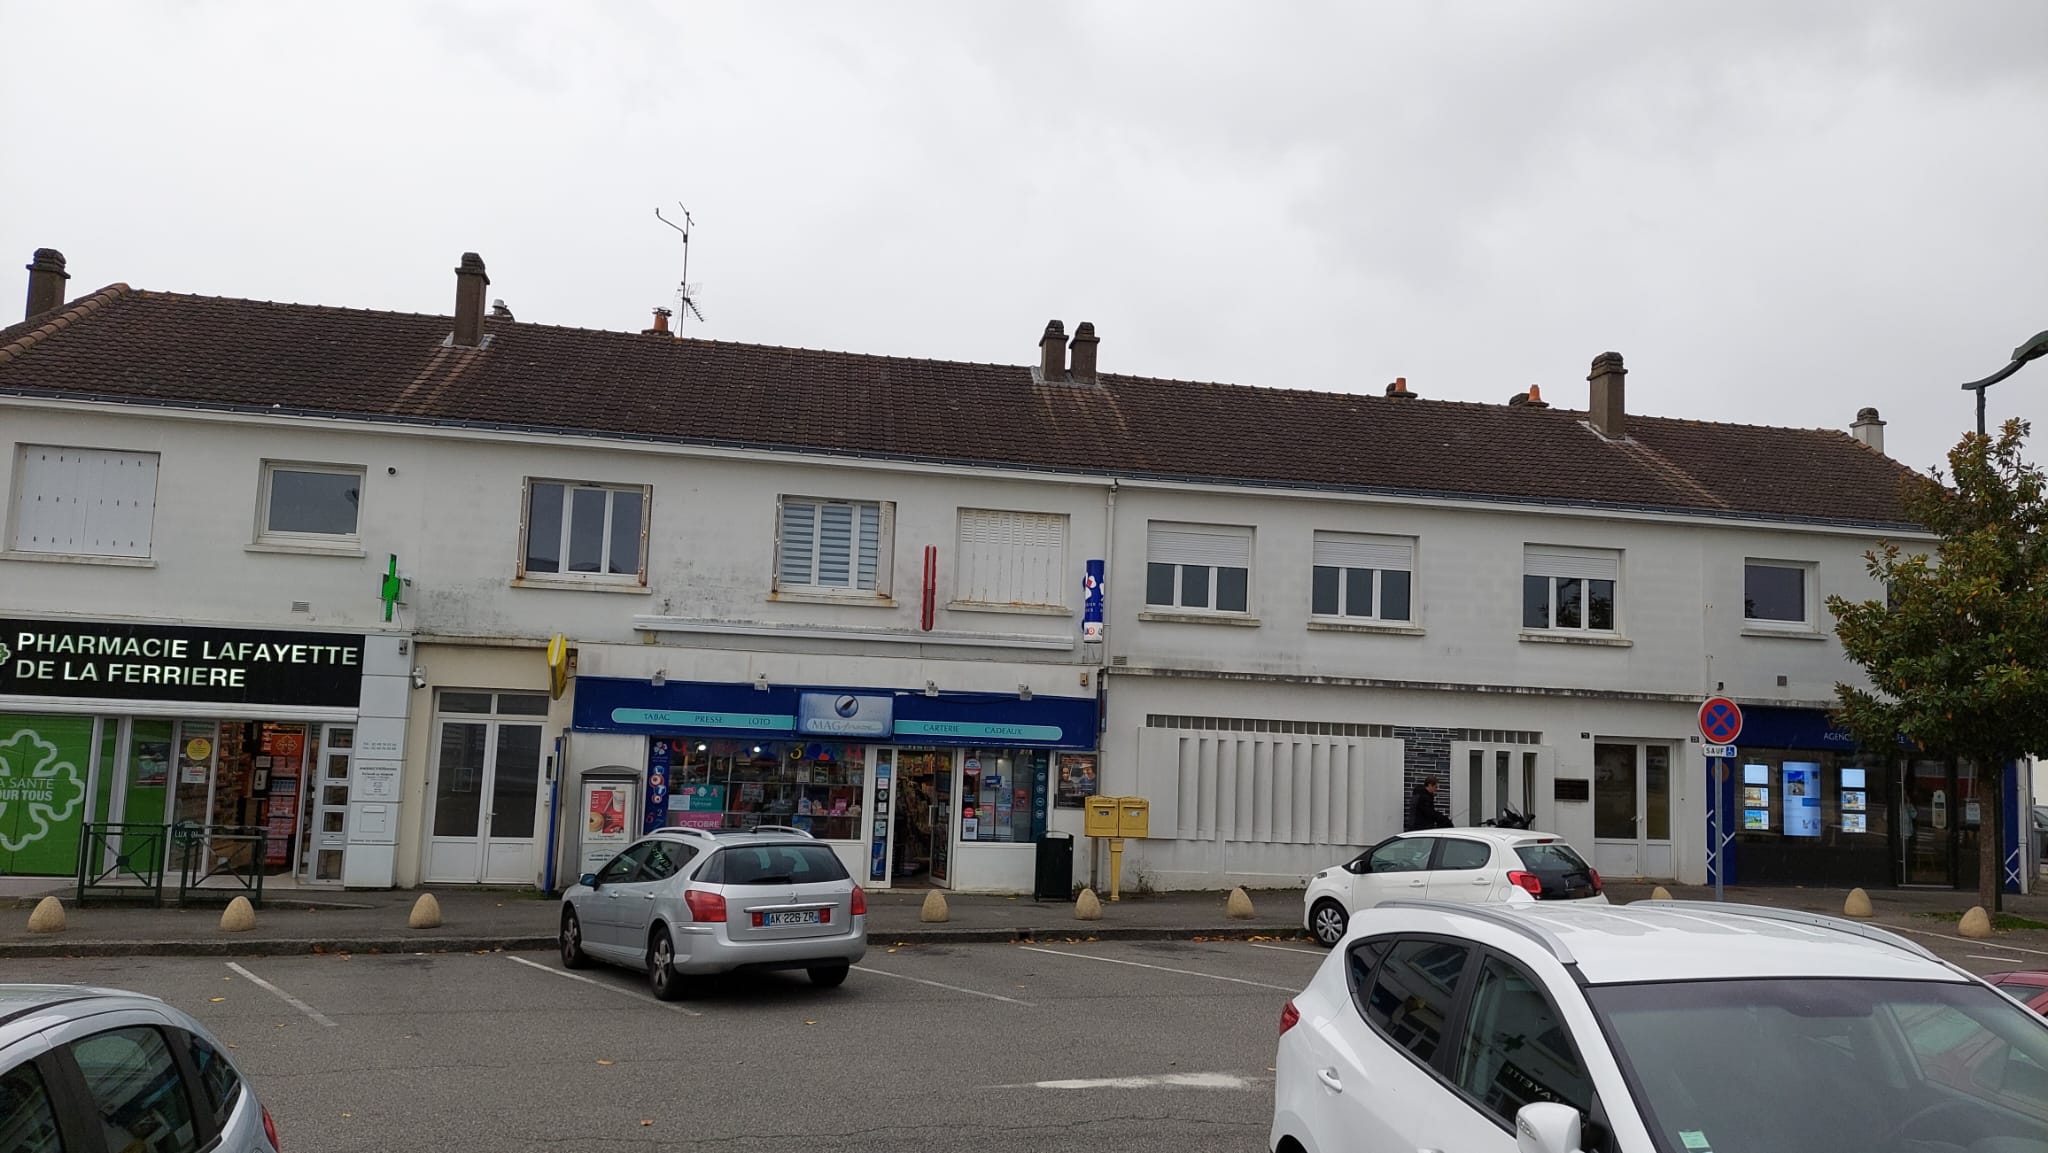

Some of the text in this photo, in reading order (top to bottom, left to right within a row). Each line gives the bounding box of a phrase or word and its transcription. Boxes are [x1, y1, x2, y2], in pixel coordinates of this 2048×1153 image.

[17, 632, 358, 665] PHARMACIE LAFAYETTE
[16, 659, 246, 687] DE LA FERRIERE
[644, 713, 771, 726] TABAC PRESSE LOTO
[923, 723, 1023, 736] CARTERIE CADEAUX
[1823, 732, 1851, 741] AGENC
[1705, 746, 1725, 755] SAUF
[9, 776, 55, 790] SANTE
[22, 788, 53, 802] TOUS
[679, 819, 721, 828] OCTOBRE
